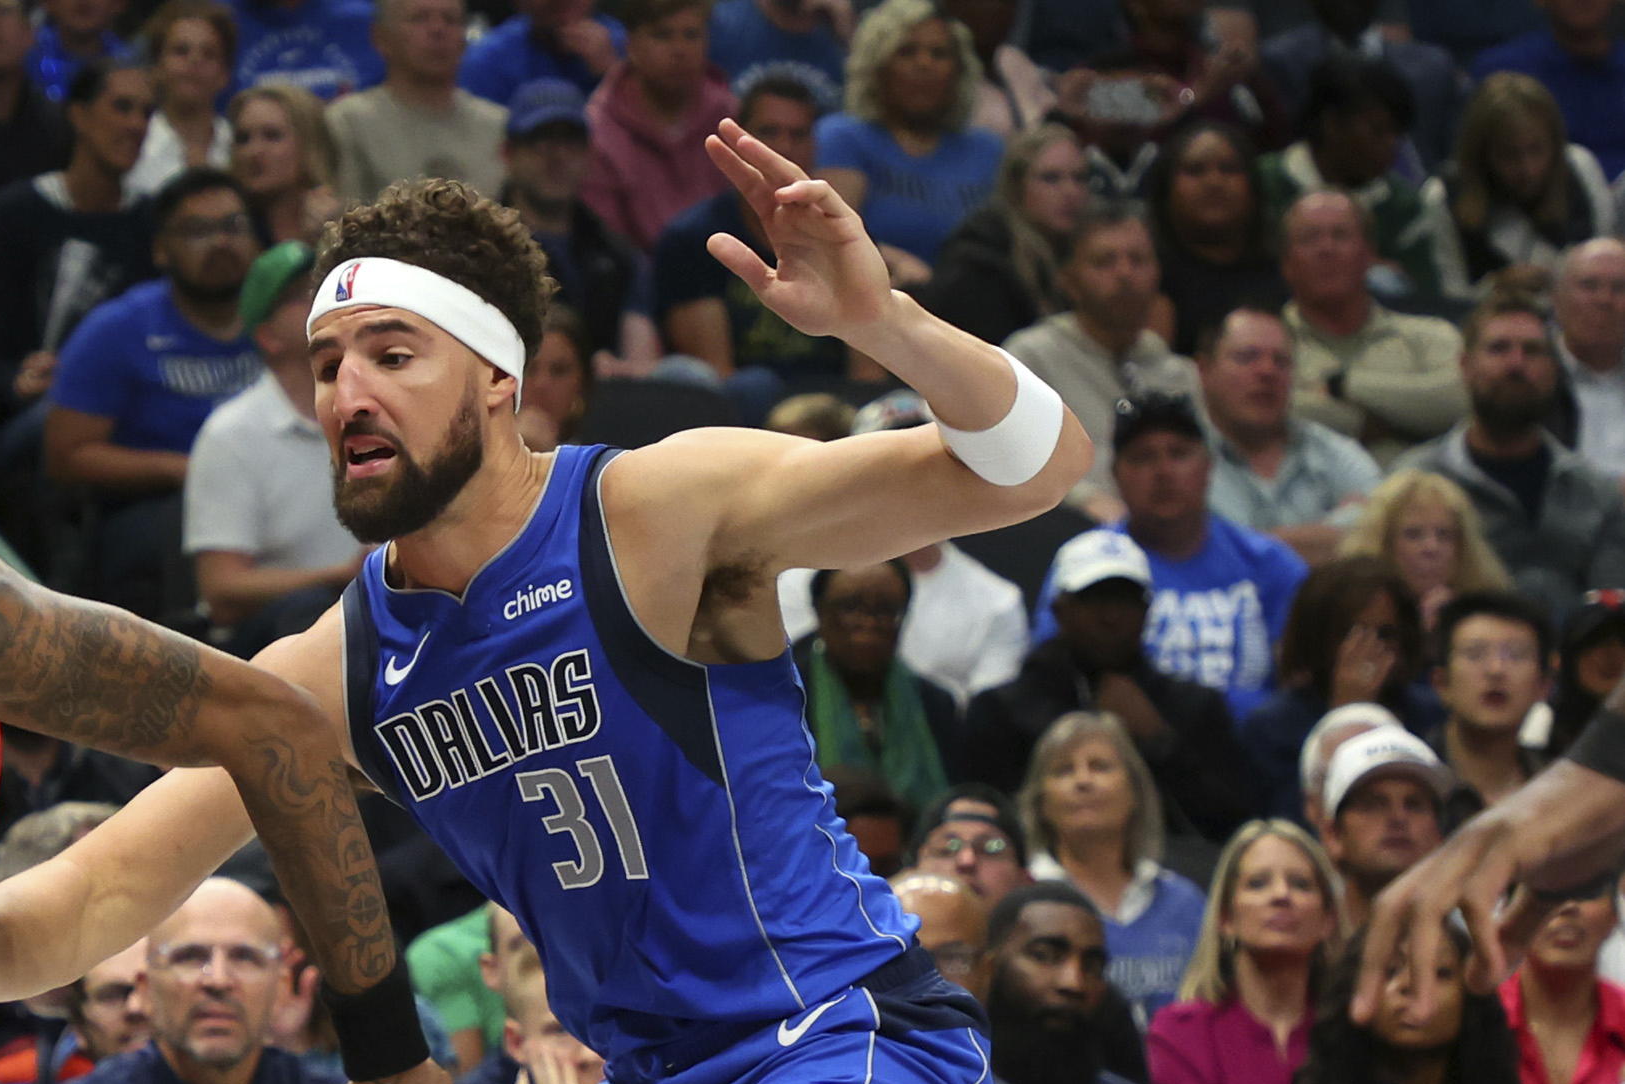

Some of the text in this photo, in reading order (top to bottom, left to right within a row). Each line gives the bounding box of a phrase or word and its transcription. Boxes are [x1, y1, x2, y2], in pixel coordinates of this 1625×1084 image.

[503, 578, 573, 620] chime
[374, 648, 603, 803] DALLAS
[514, 754, 650, 890] 31
